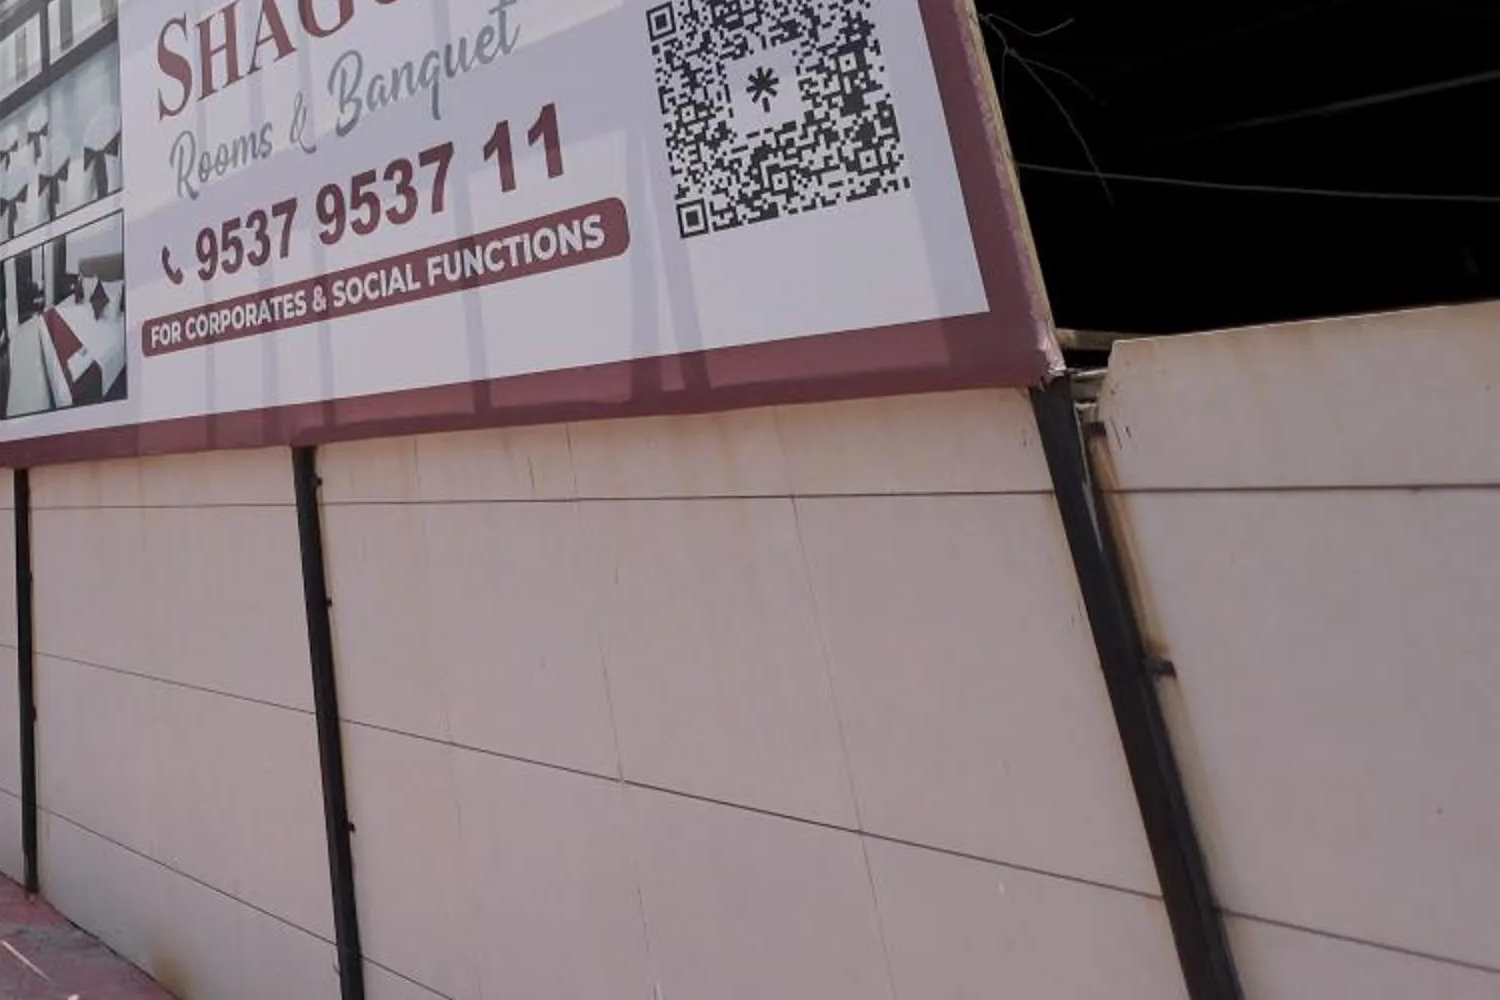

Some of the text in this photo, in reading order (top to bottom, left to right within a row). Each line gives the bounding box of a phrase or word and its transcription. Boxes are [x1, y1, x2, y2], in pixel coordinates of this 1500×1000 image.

[169, 122, 273, 201] Rooms
[289, 92, 317, 155] &
[195, 101, 564, 281] 9537 9537 11
[150, 214, 606, 349] FOR CORPORATES & SOCIAL FUNCTIONS
